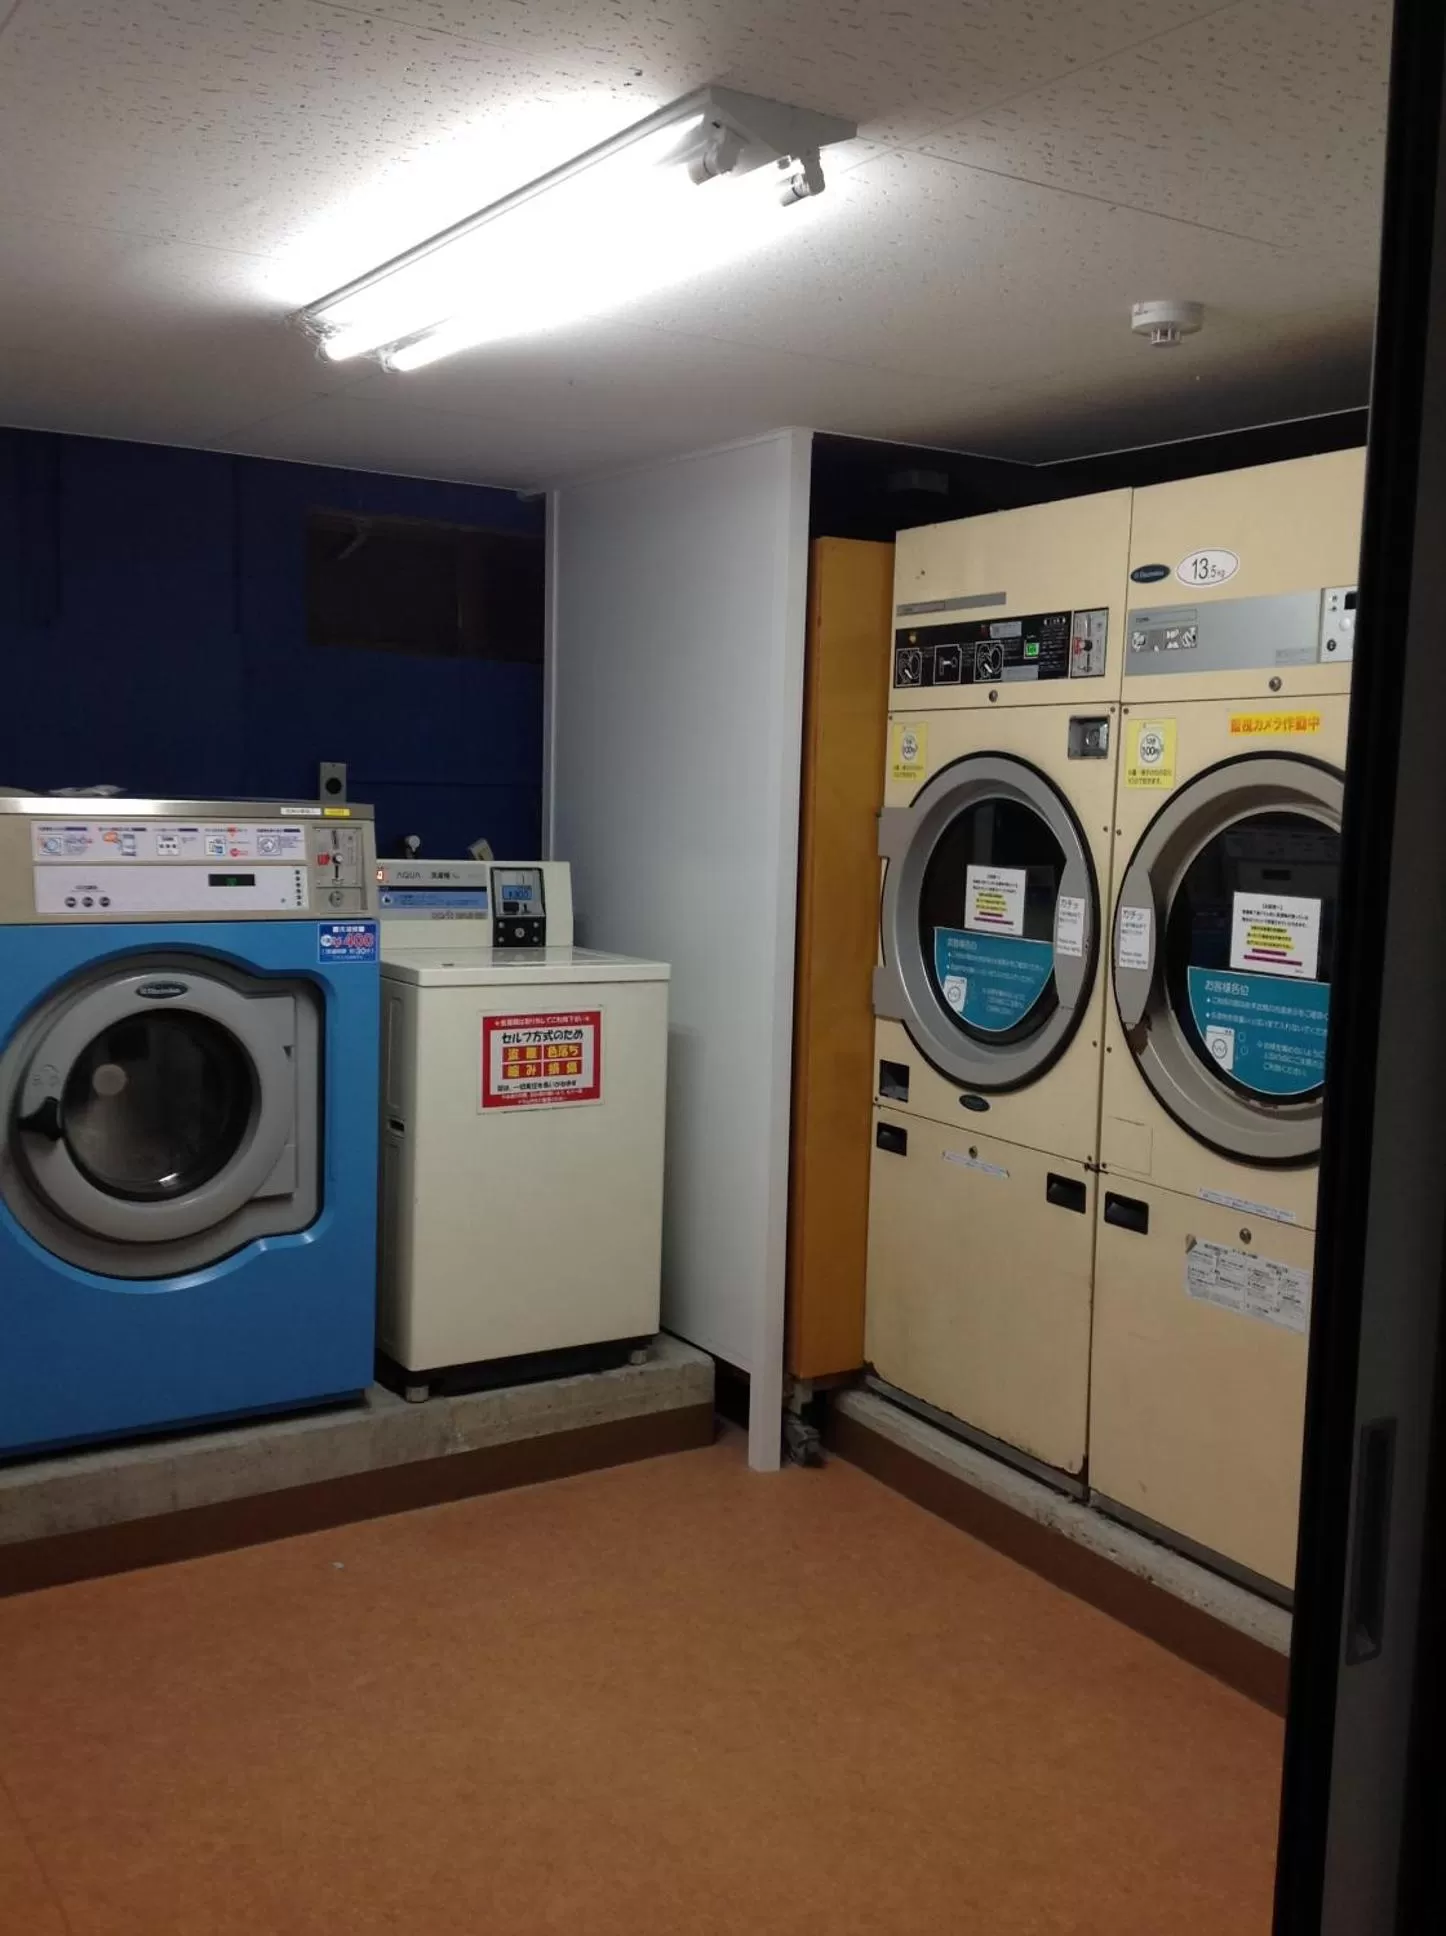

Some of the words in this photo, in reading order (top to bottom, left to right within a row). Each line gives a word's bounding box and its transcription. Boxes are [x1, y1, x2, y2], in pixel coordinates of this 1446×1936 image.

[396, 871, 421, 880] AQUA
[502, 1029, 584, 1044] セルフ方式のため
